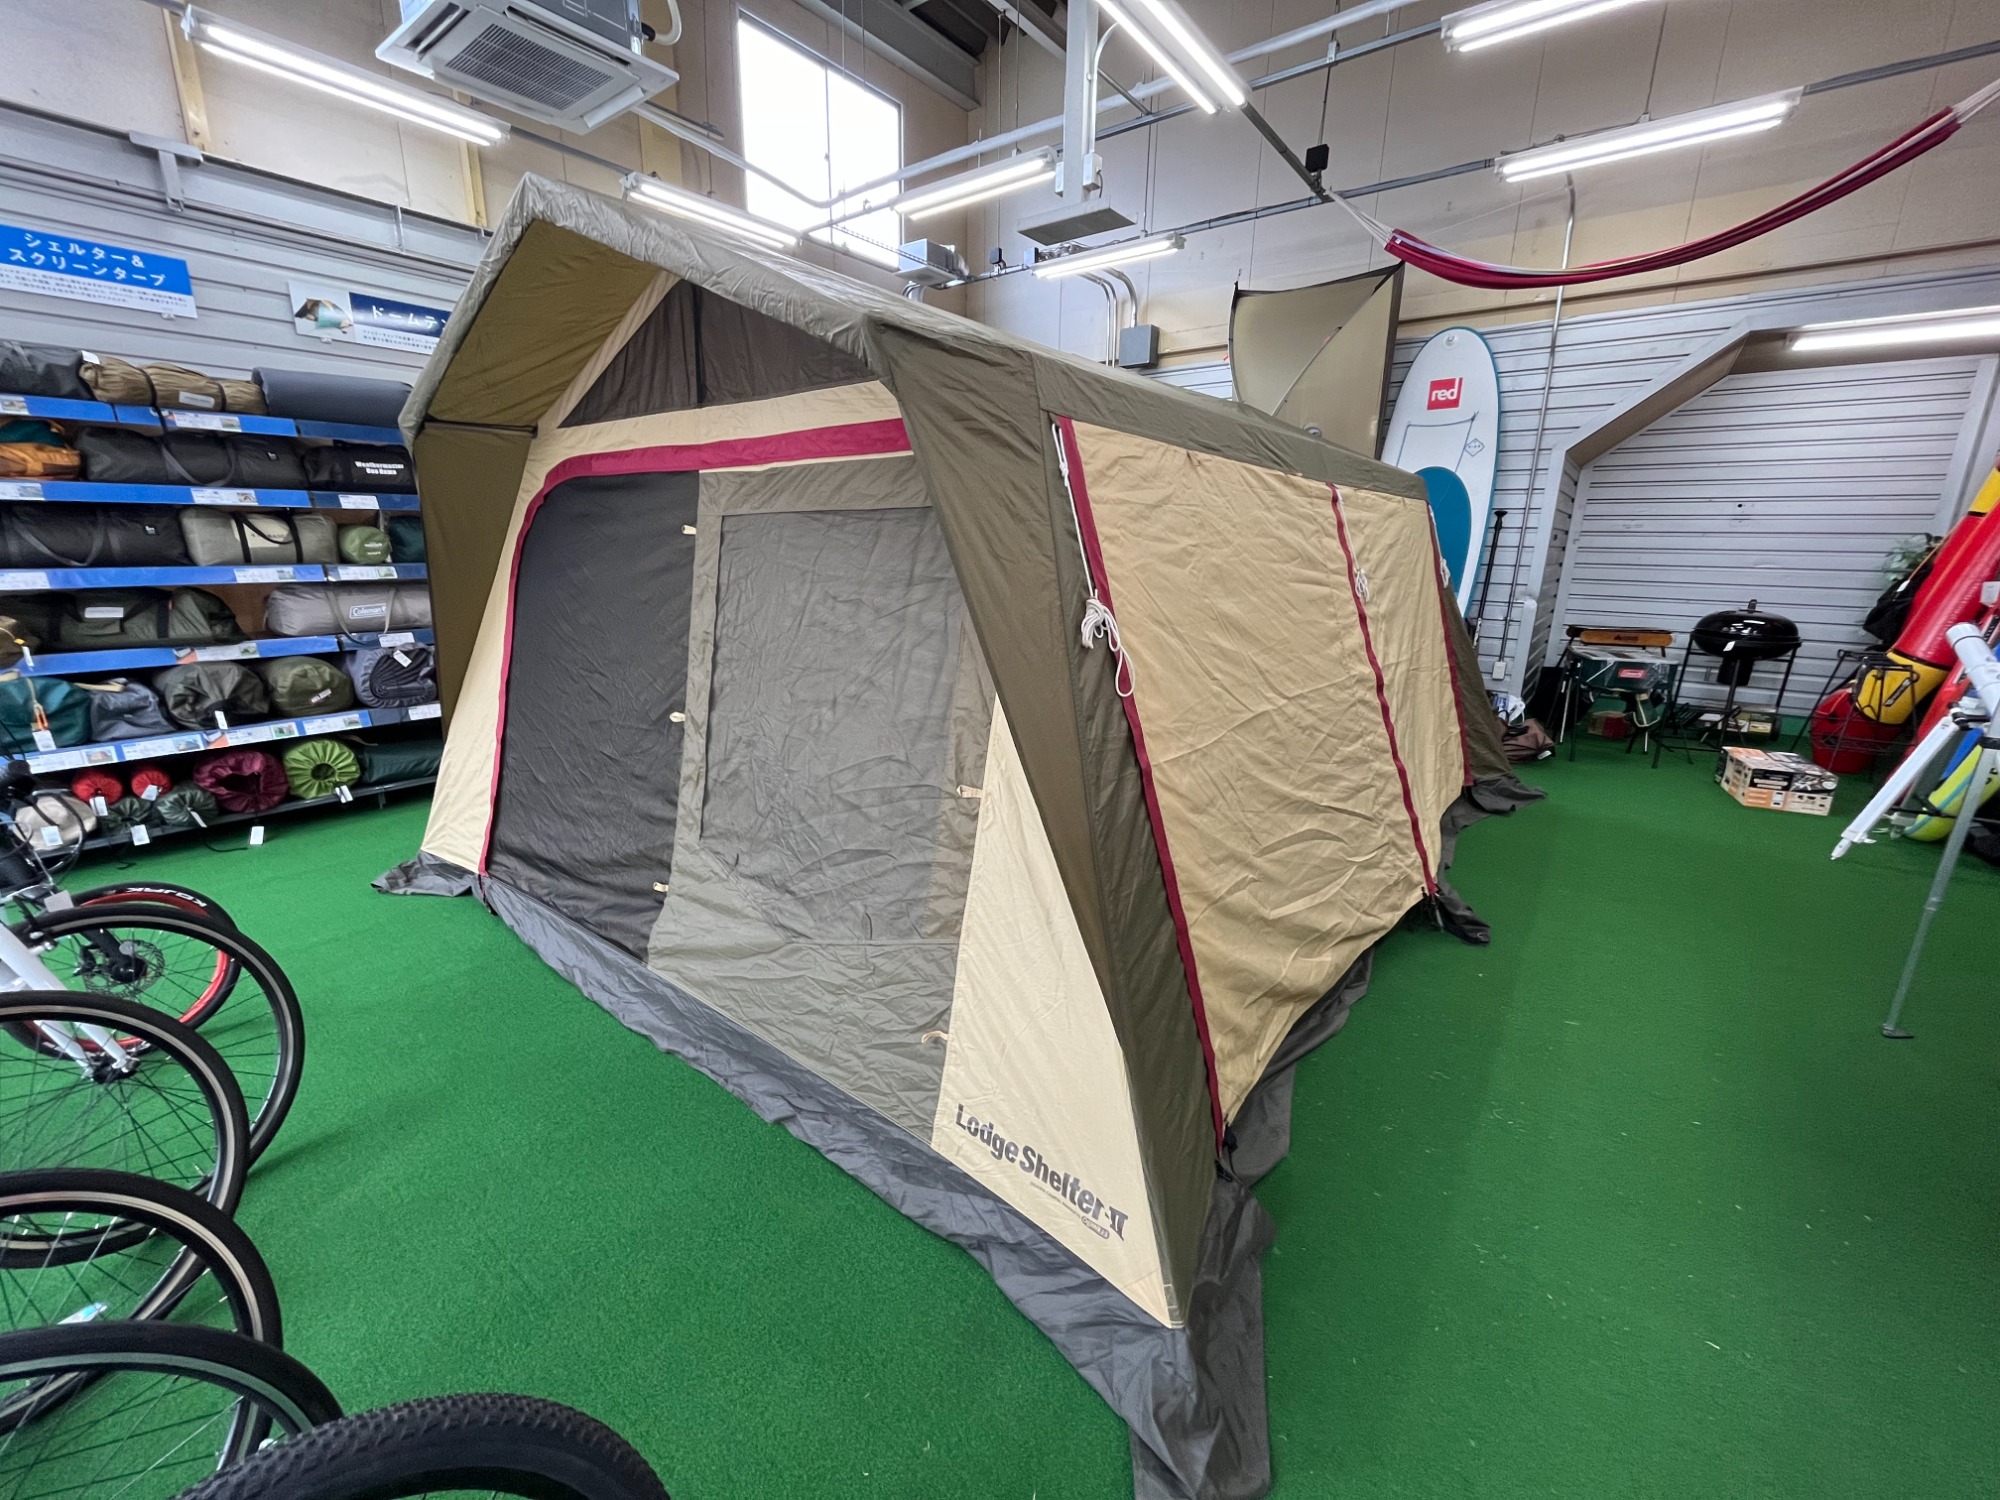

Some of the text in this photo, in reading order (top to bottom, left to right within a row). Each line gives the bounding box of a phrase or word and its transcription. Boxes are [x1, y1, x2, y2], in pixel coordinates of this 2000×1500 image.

[1430, 377, 1463, 402] red
[352, 606, 381, 616] Coleman
[126, 887, 208, 908] KOJAK
[955, 1103, 1019, 1164] Lodge
